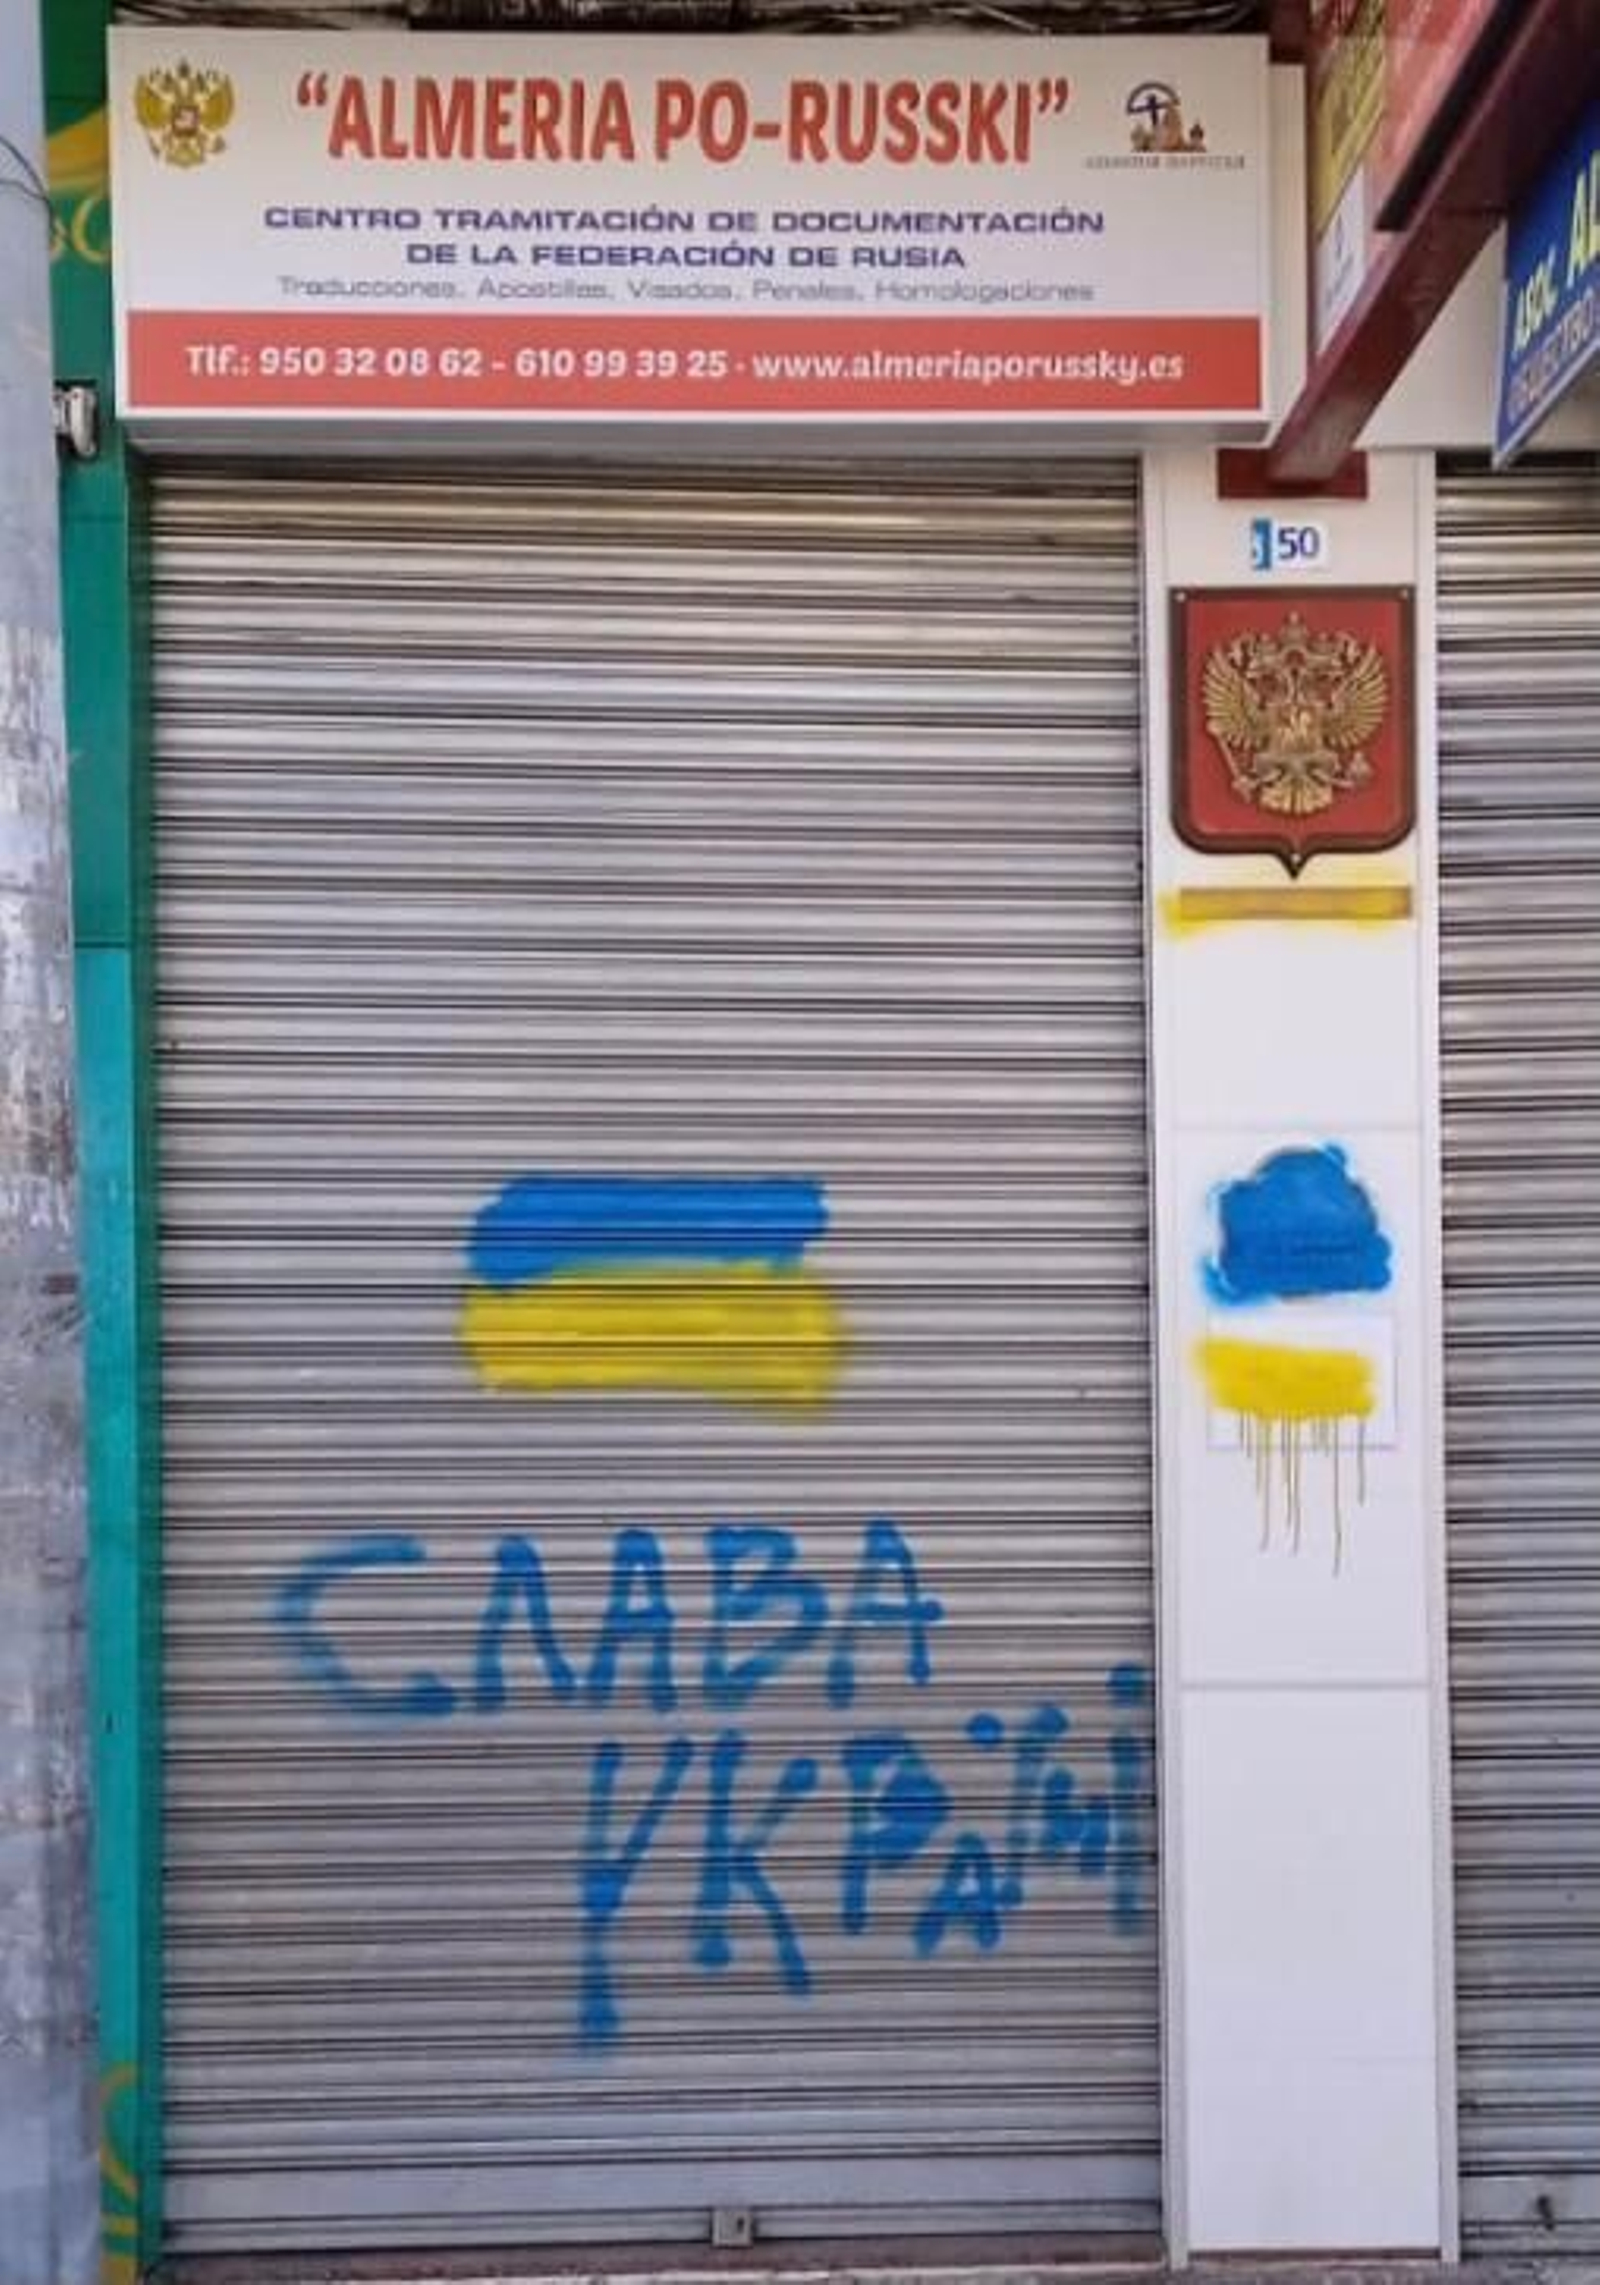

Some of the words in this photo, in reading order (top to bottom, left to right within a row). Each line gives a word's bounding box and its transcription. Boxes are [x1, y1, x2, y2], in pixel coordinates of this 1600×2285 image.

[264, 207, 422, 230] CENTRO
[435, 203, 694, 232] TRAMITACIÓN
[708, 211, 757, 233] DE
[772, 205, 1104, 233] DOCUMENTACIÓN
[407, 244, 457, 265] DE
[471, 244, 519, 266] LA
[532, 240, 775, 267] FEDERACIÓN
[788, 246, 838, 268] DE
[852, 246, 966, 268] RUSIA
[874, 281, 1096, 303] Homologaciones
[259, 348, 326, 376] 950
[334, 348, 376, 376] 32
[385, 349, 430, 377] 08
[439, 349, 482, 377] 62
[515, 349, 574, 378] 610
[584, 350, 628, 378] 99
[636, 350, 678, 378] 39
[686, 350, 728, 378] 25
[752, 350, 1185, 385] www.almeriaporussky.es
[1277, 526, 1321, 560] 50
[274, 1519, 946, 1715] СЛАВА
